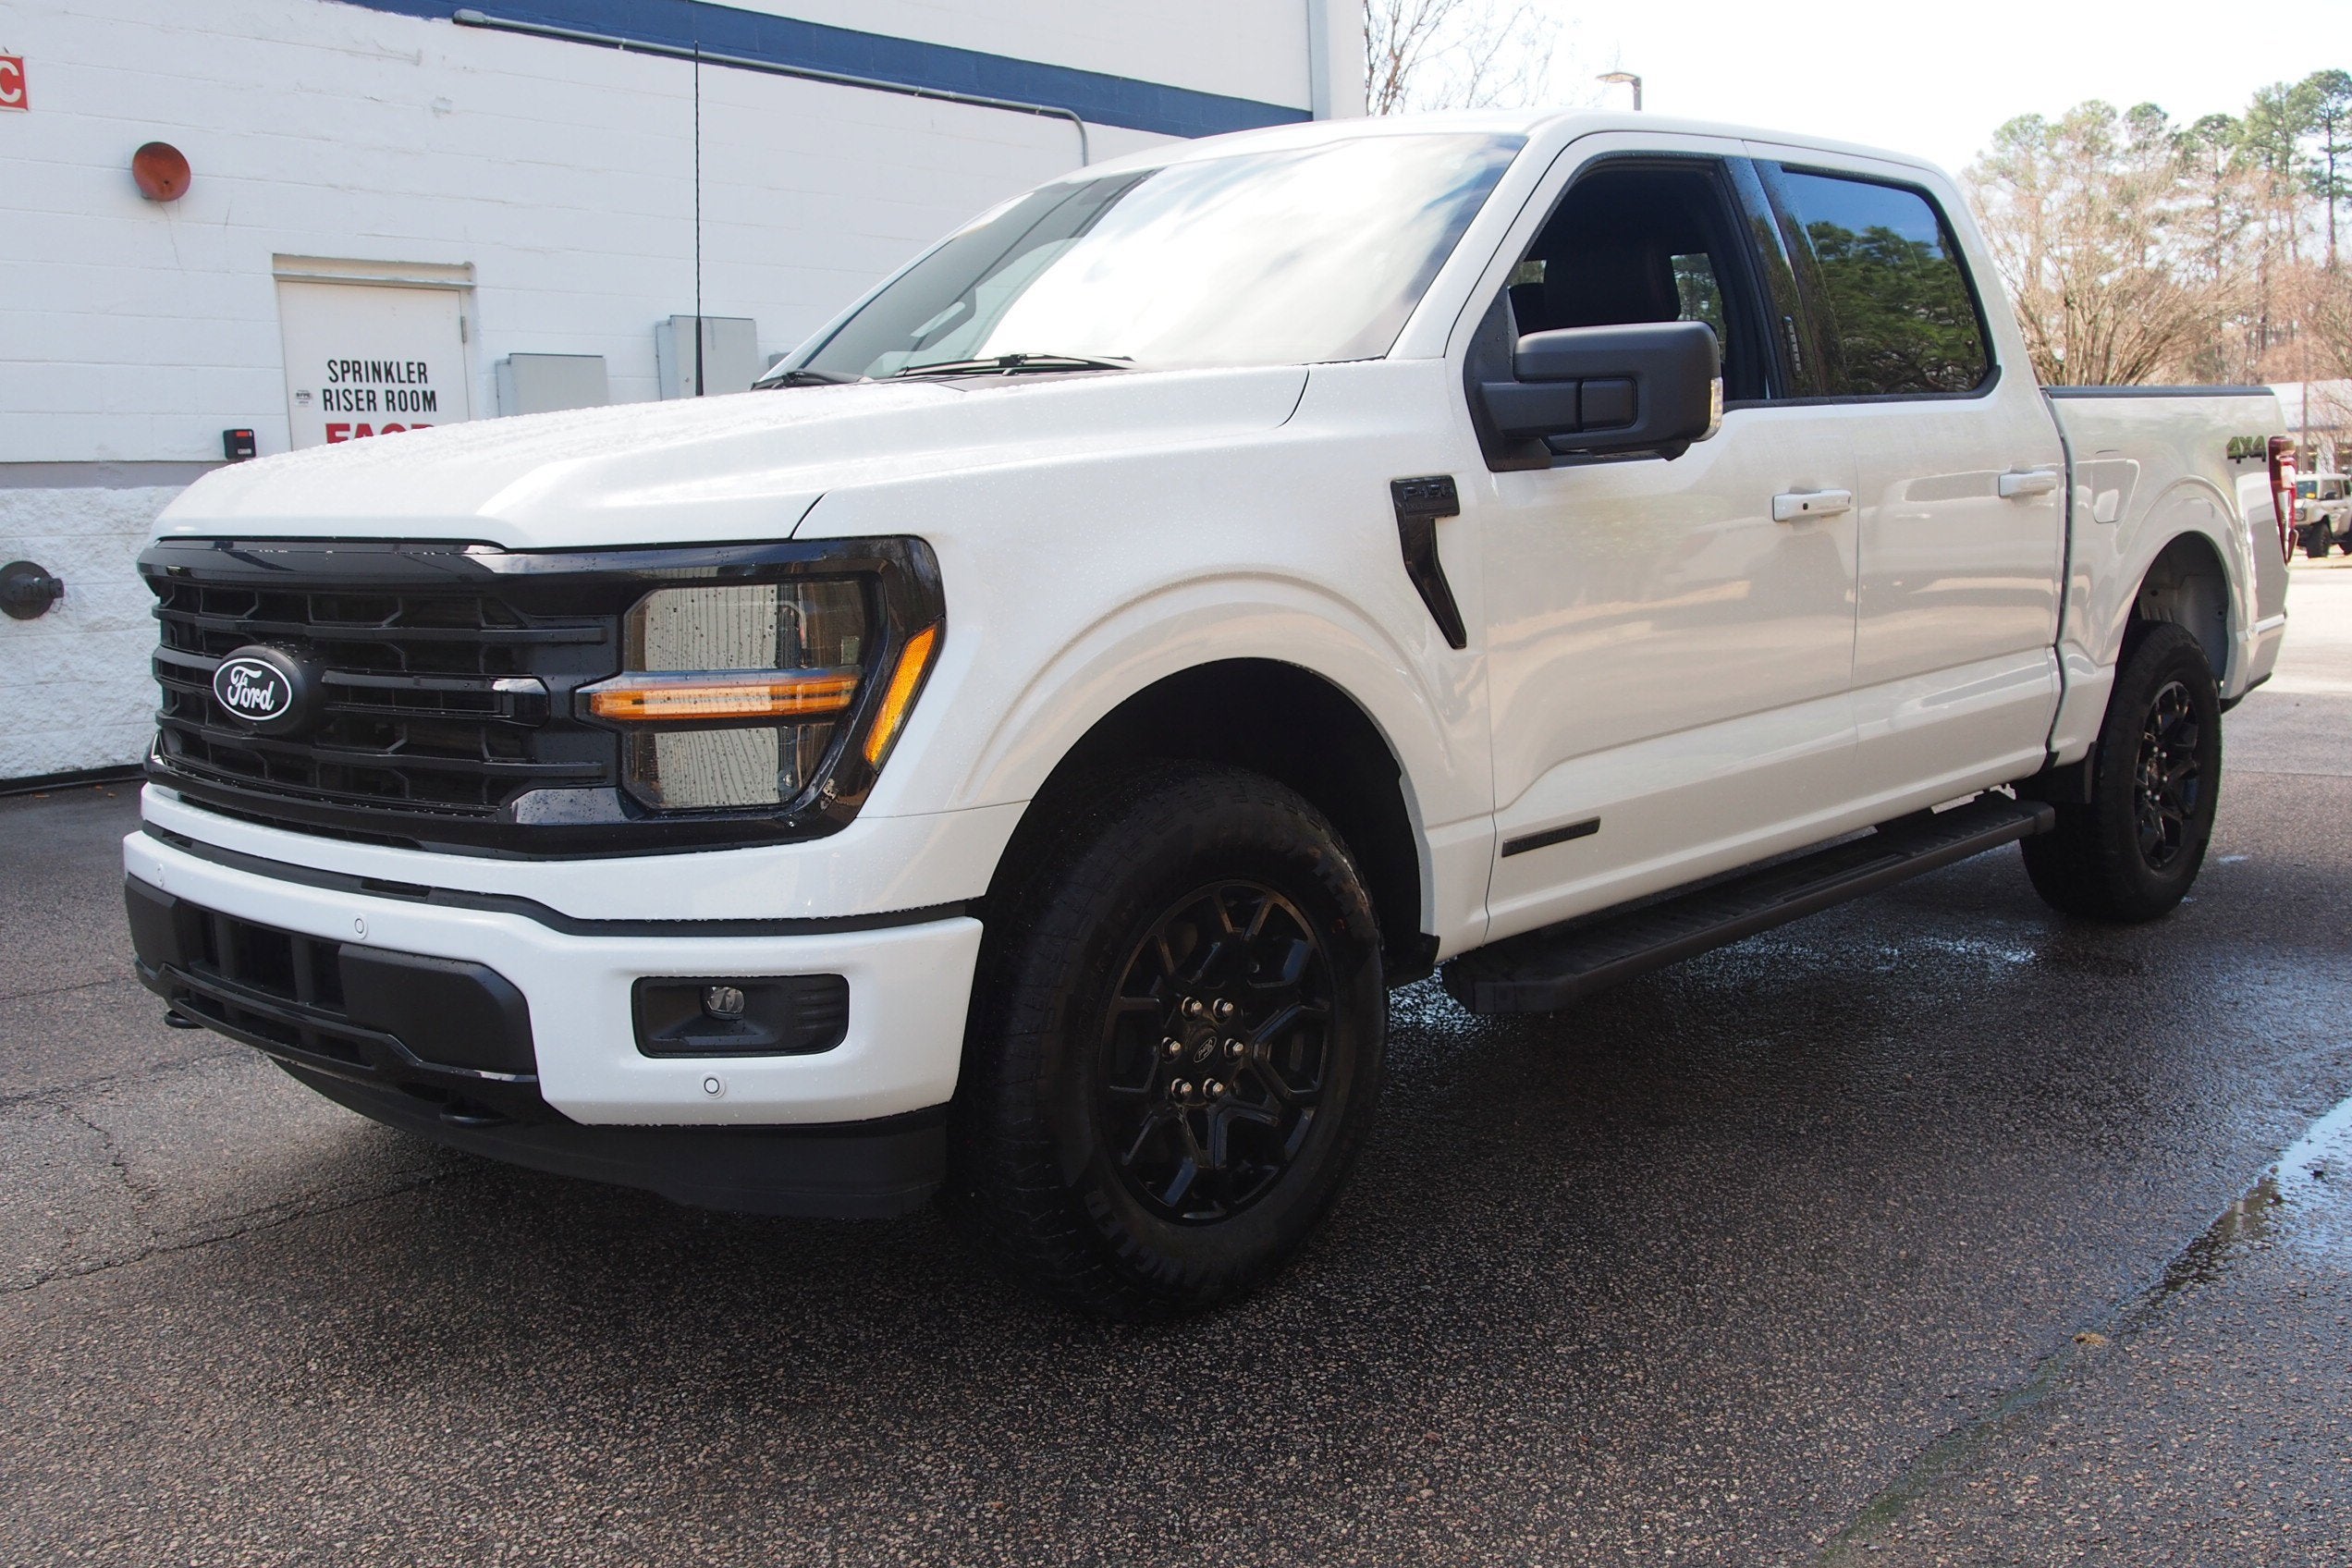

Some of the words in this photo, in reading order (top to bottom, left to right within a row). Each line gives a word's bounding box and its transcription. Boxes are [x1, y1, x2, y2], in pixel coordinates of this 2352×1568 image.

[0, 60, 22, 104] C
[327, 359, 428, 384] SPRINKLER
[323, 388, 377, 412] RISER
[386, 389, 437, 412] ROOM
[227, 666, 275, 711] Ford
